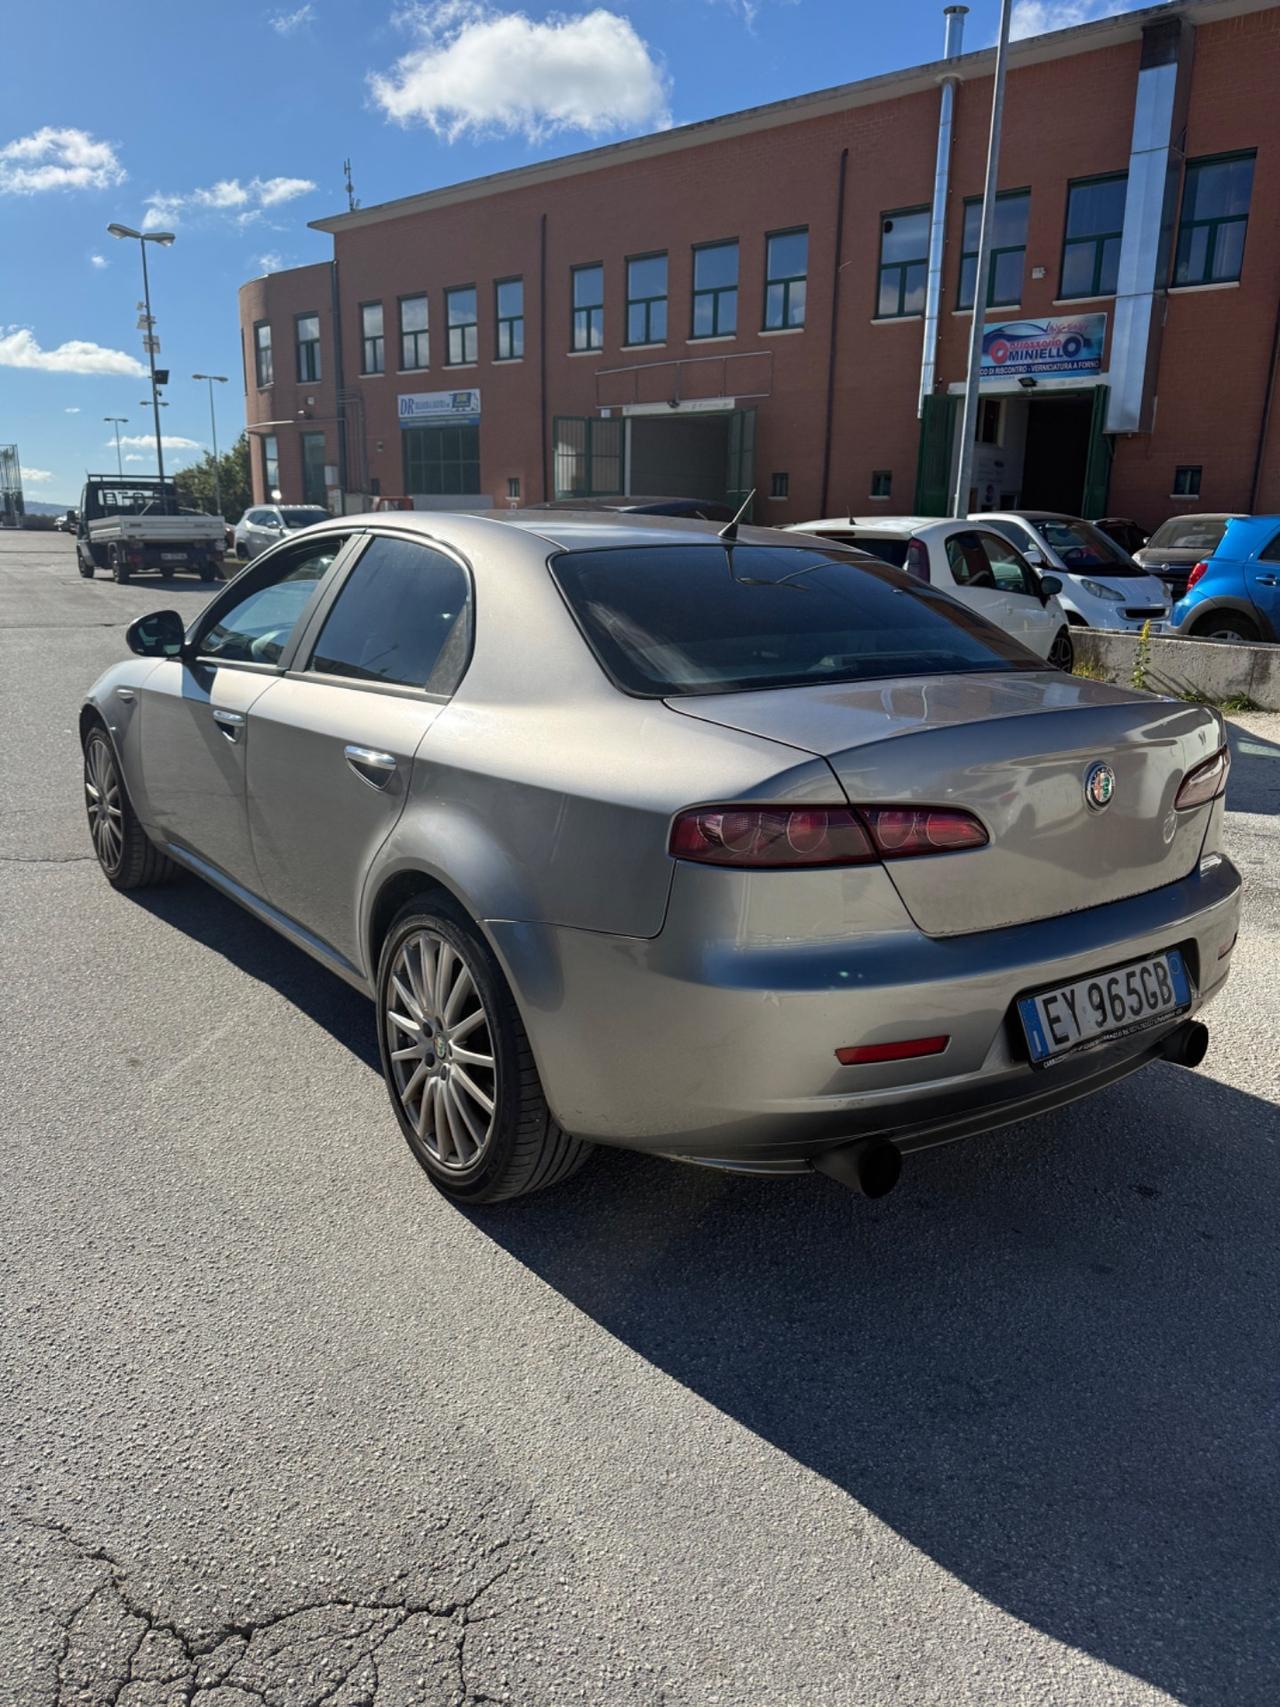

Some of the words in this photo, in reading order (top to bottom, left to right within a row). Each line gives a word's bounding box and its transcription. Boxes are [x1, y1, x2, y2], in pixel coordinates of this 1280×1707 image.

[1008, 336, 1082, 360] MINIELLO
[1031, 362, 1072, 373] VERNICIATURA
[1079, 360, 1099, 369] FORNO
[400, 398, 414, 415] DR
[1042, 989, 1082, 1045] EY
